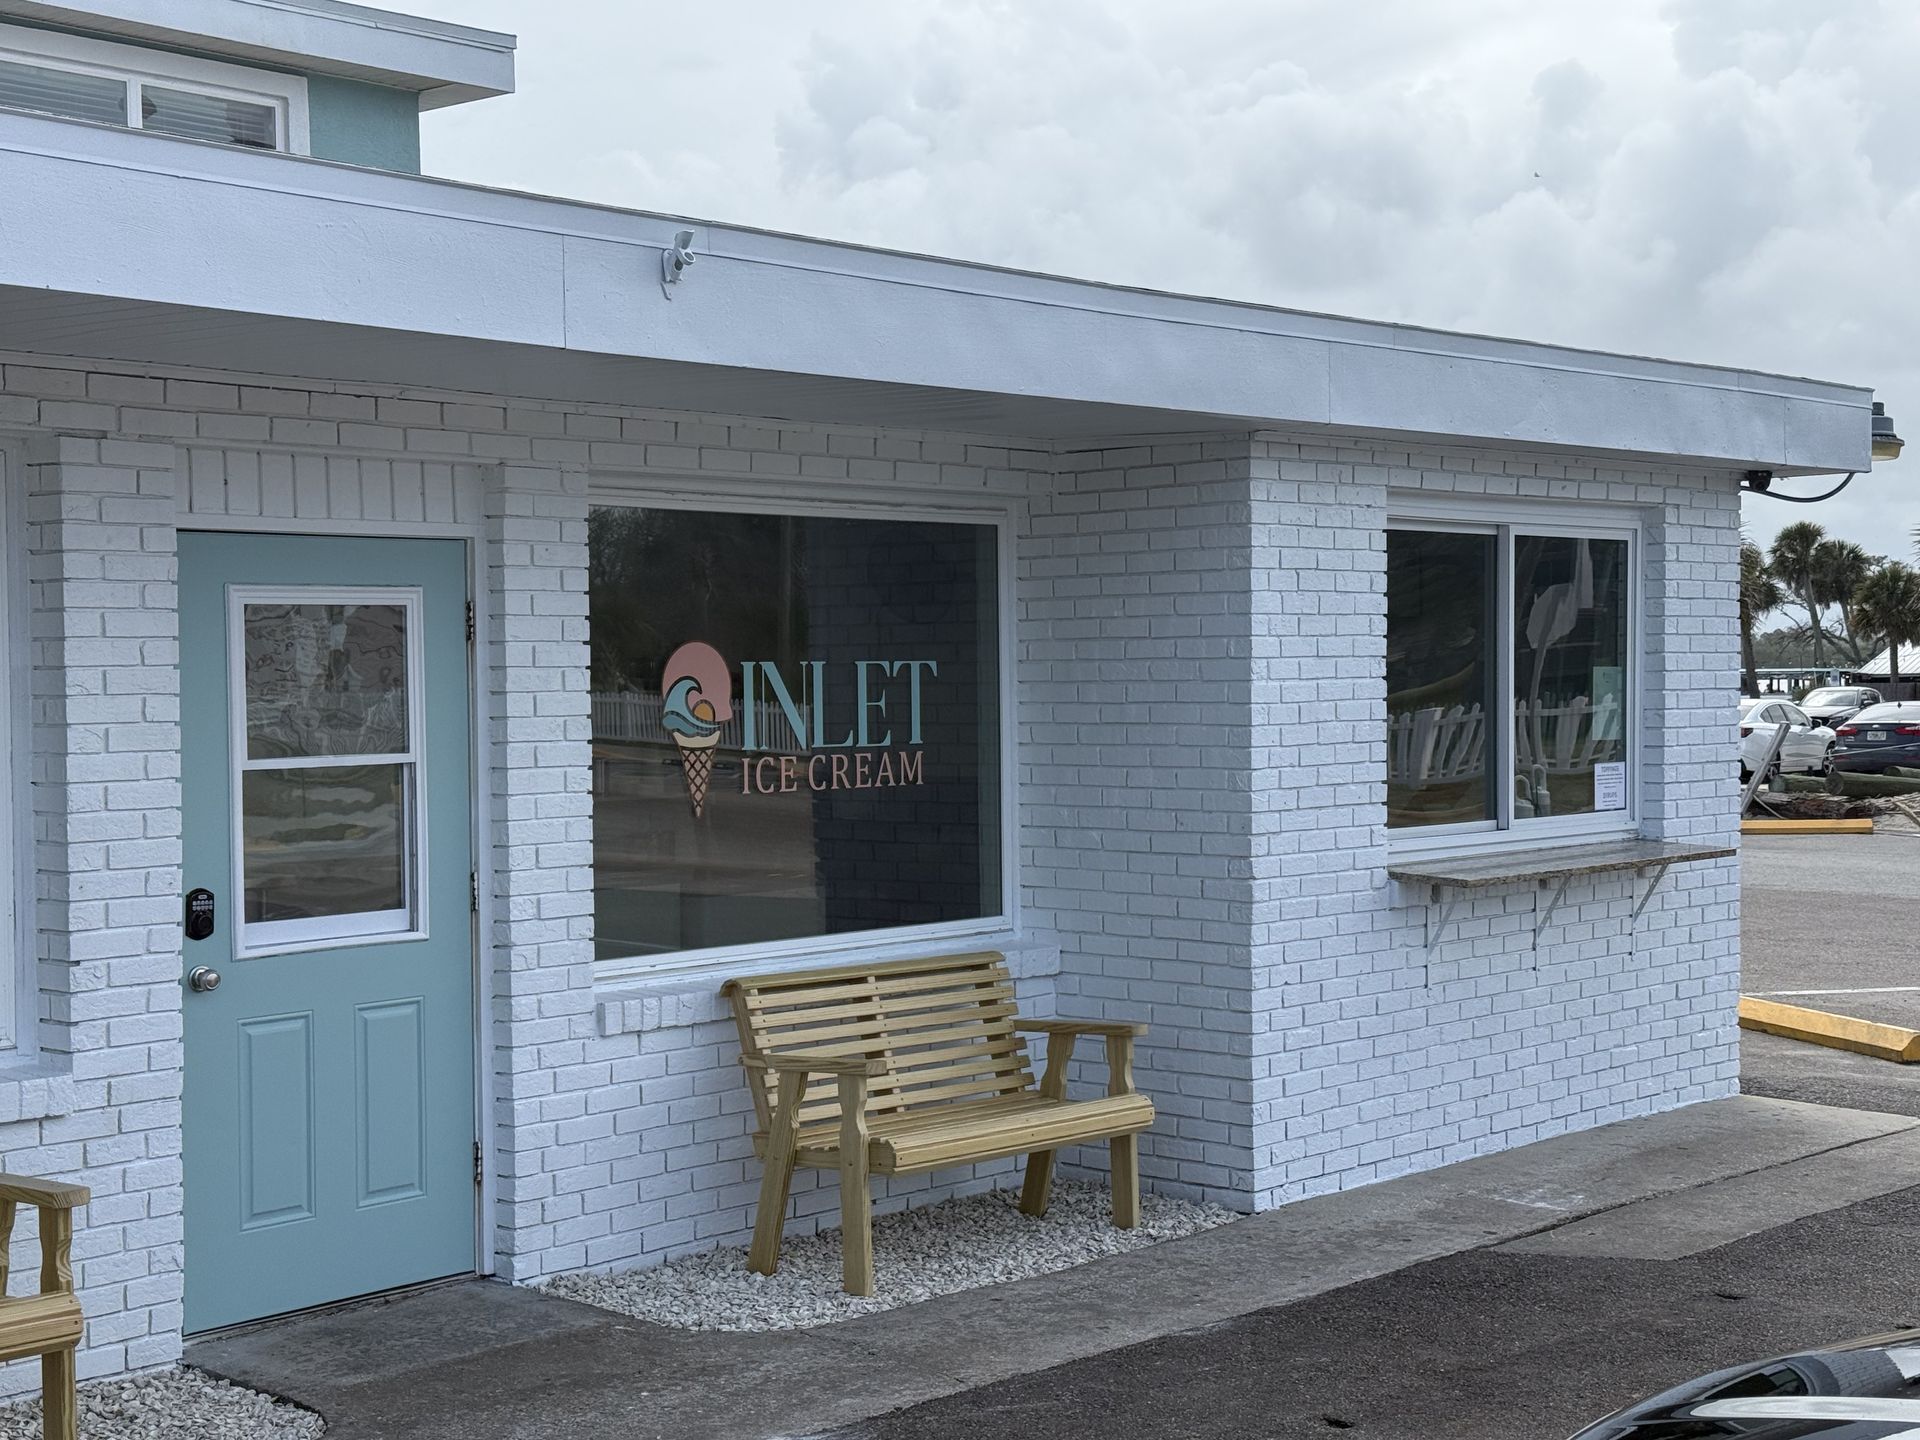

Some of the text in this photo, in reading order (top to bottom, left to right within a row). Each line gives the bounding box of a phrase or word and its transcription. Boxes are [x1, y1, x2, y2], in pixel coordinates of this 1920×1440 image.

[740, 660, 938, 751] INLET
[742, 750, 924, 795] ICE CREAM
